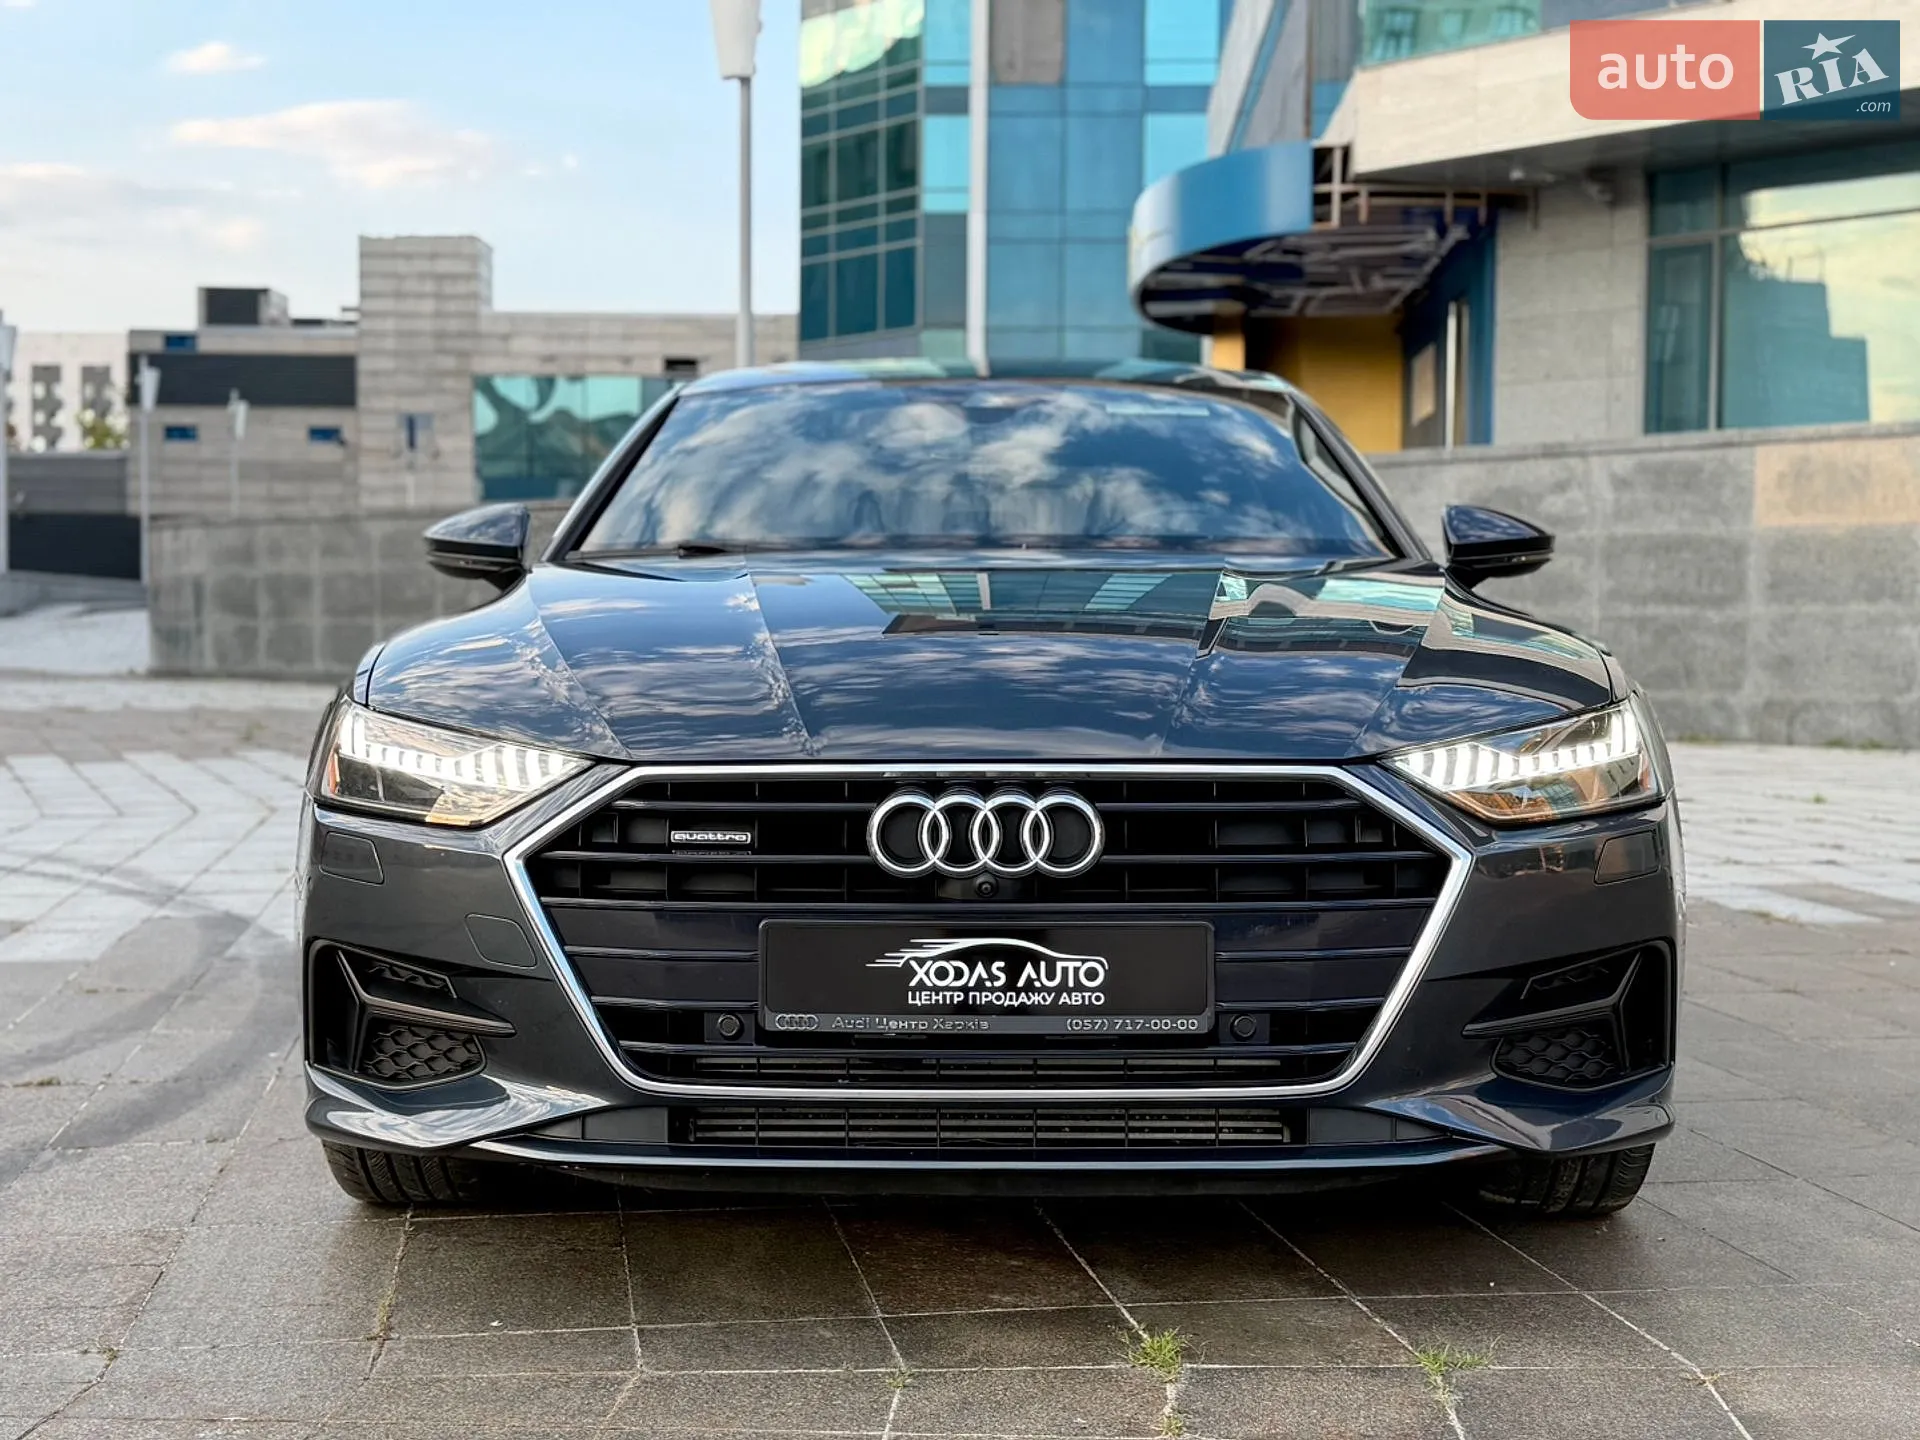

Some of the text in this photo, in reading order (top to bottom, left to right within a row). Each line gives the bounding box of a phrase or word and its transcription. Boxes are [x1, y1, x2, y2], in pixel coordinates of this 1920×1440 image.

[674, 833, 747, 842] quattro
[1017, 960, 1105, 987] AUTO
[908, 991, 1105, 1007] ЦЕНТР ПРОДАЖУ АВТО
[831, 1016, 871, 1029] Audi
[875, 1017, 928, 1031] Центр
[1066, 1018, 1199, 1031] (057) 717-00-00
